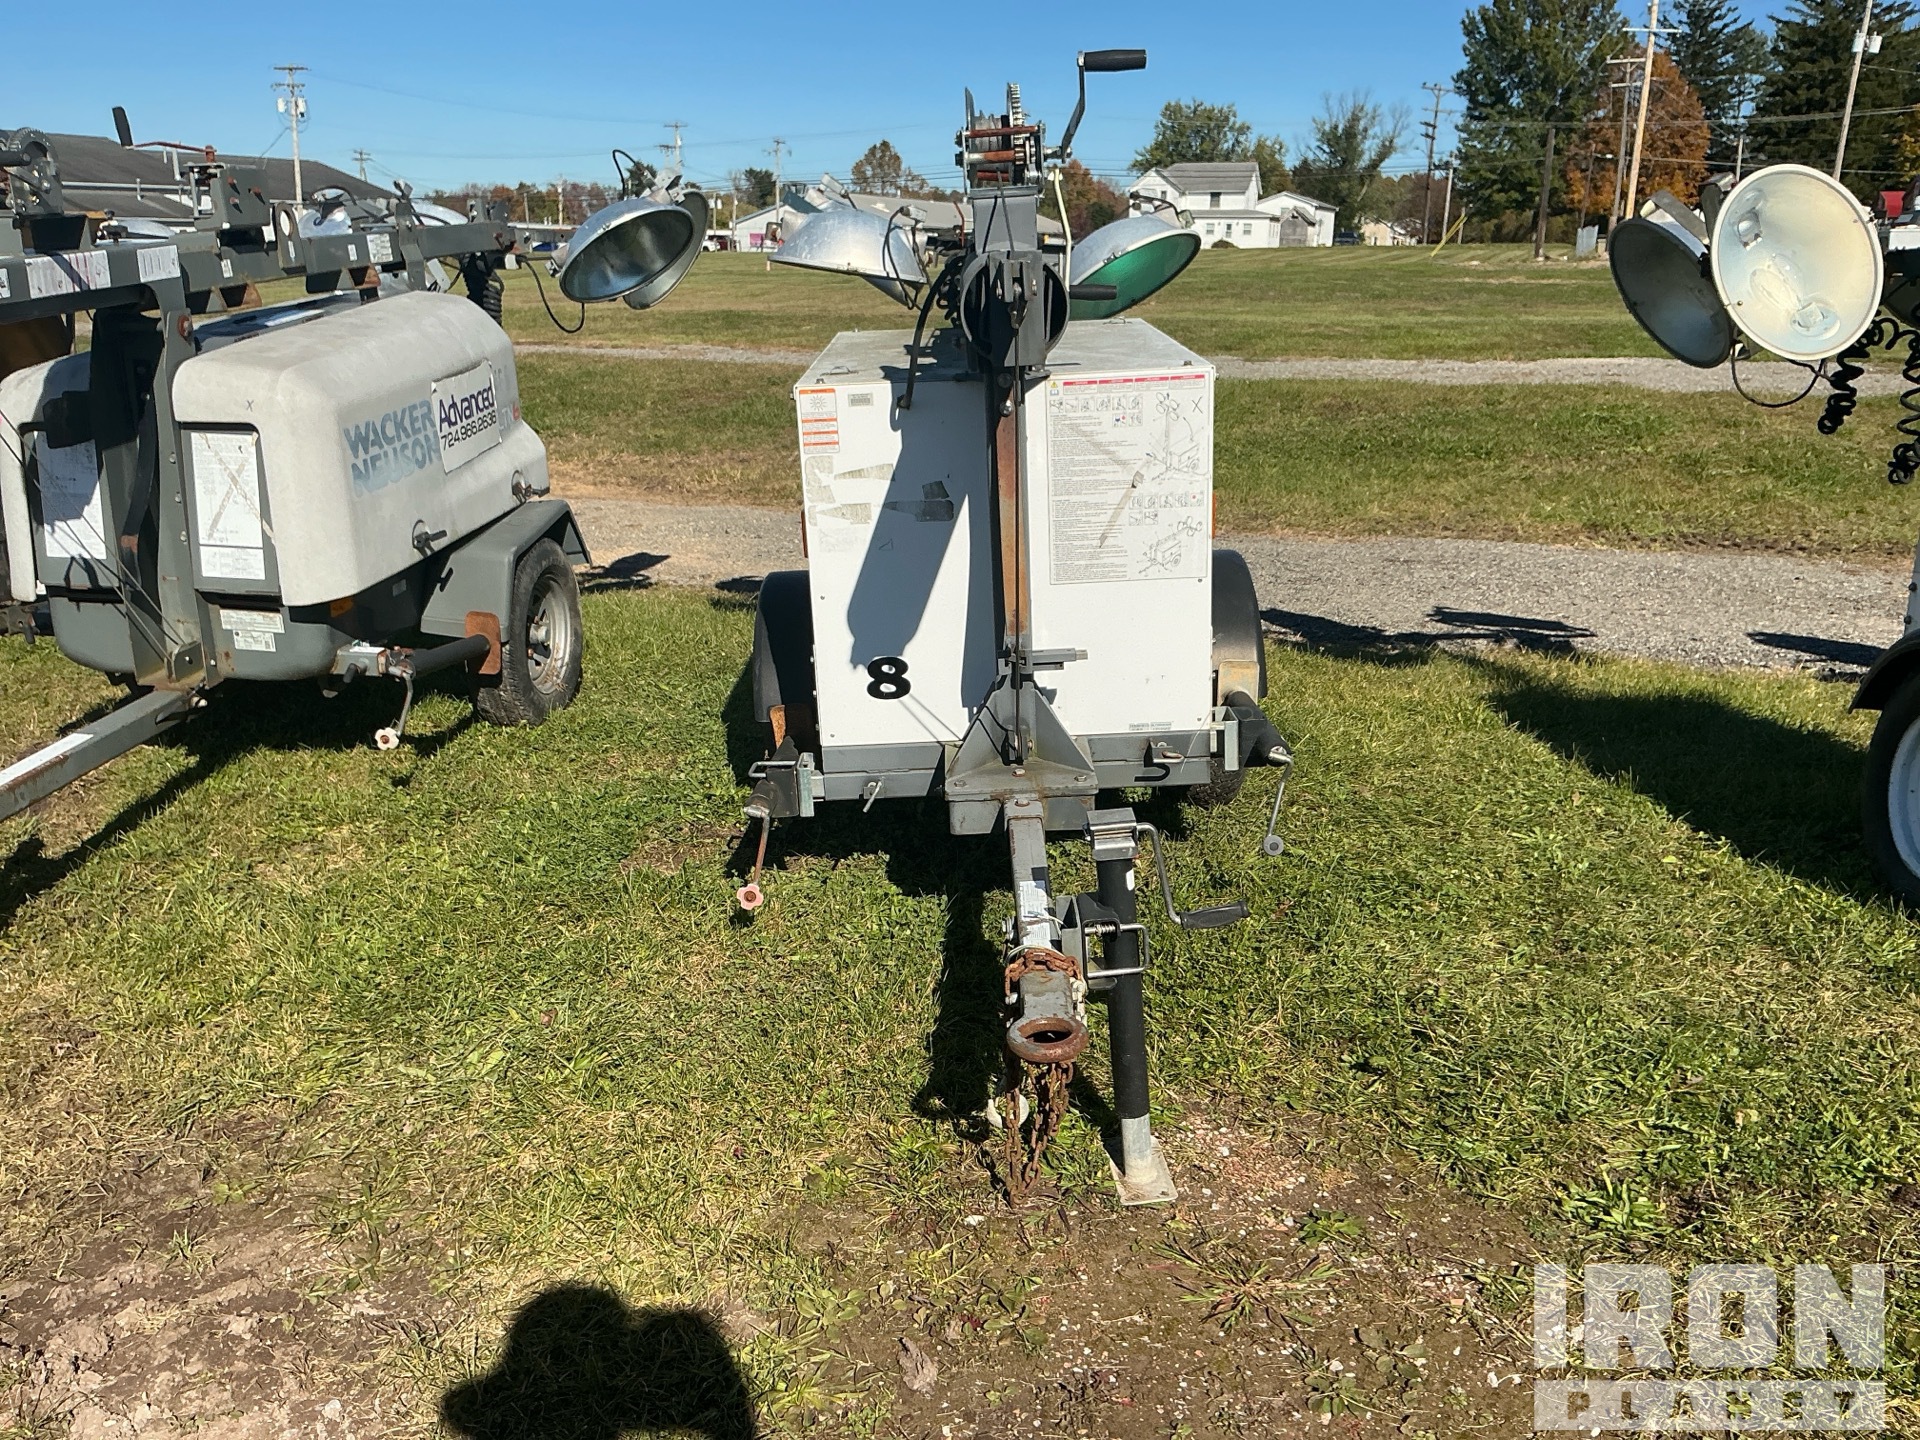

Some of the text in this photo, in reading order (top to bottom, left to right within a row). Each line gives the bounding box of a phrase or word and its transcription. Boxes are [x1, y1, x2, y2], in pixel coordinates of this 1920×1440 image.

[344, 399, 437, 459] WACKER
[439, 377, 495, 433] Advanced
[350, 432, 441, 496] NEUSON
[867, 656, 911, 700] 8
